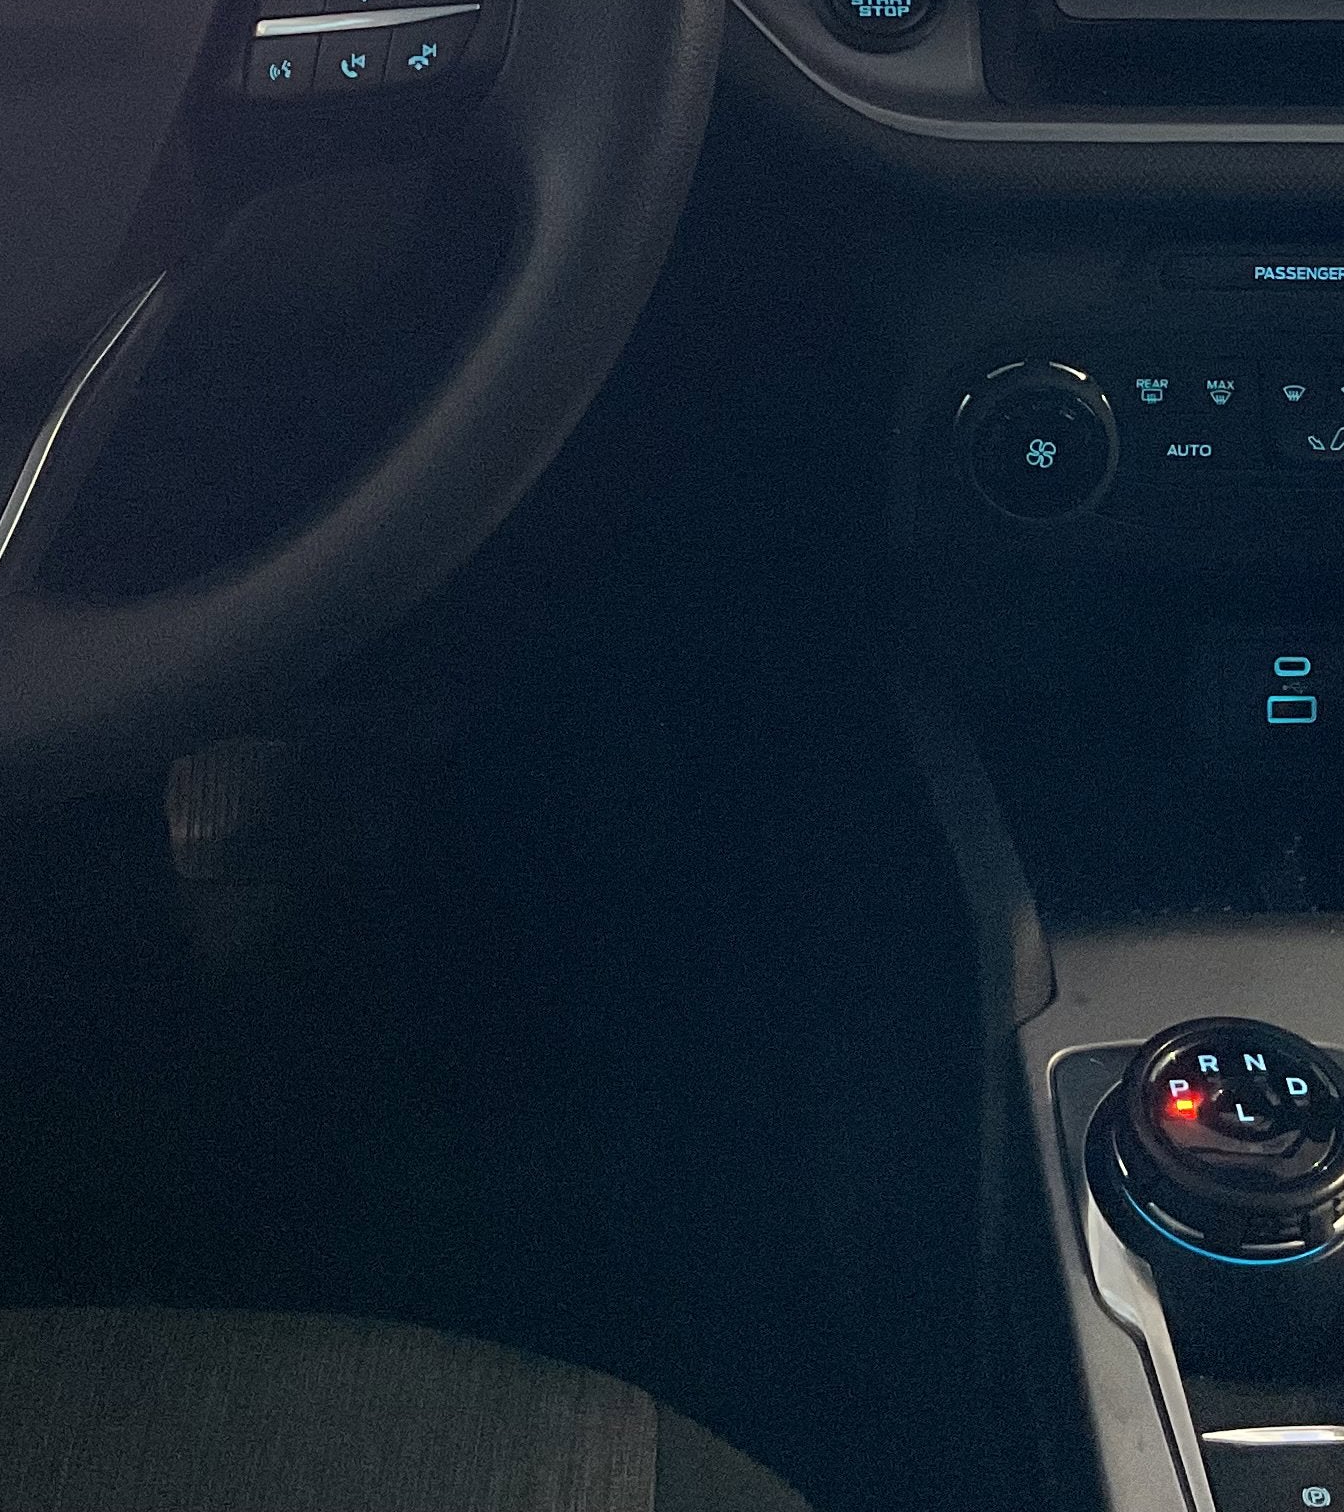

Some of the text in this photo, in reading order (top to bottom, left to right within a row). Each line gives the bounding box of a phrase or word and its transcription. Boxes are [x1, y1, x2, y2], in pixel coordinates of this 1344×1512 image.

[859, 6, 909, 17] STOP
[1136, 379, 1168, 388] REAR
[1207, 380, 1235, 390] MAX
[1167, 445, 1211, 456] AUTO
[1198, 1055, 1219, 1073] R
[1245, 1054, 1266, 1072] N
[1169, 1081, 1189, 1096] P
[1288, 1078, 1307, 1096] D
[1237, 1104, 1254, 1122] L
